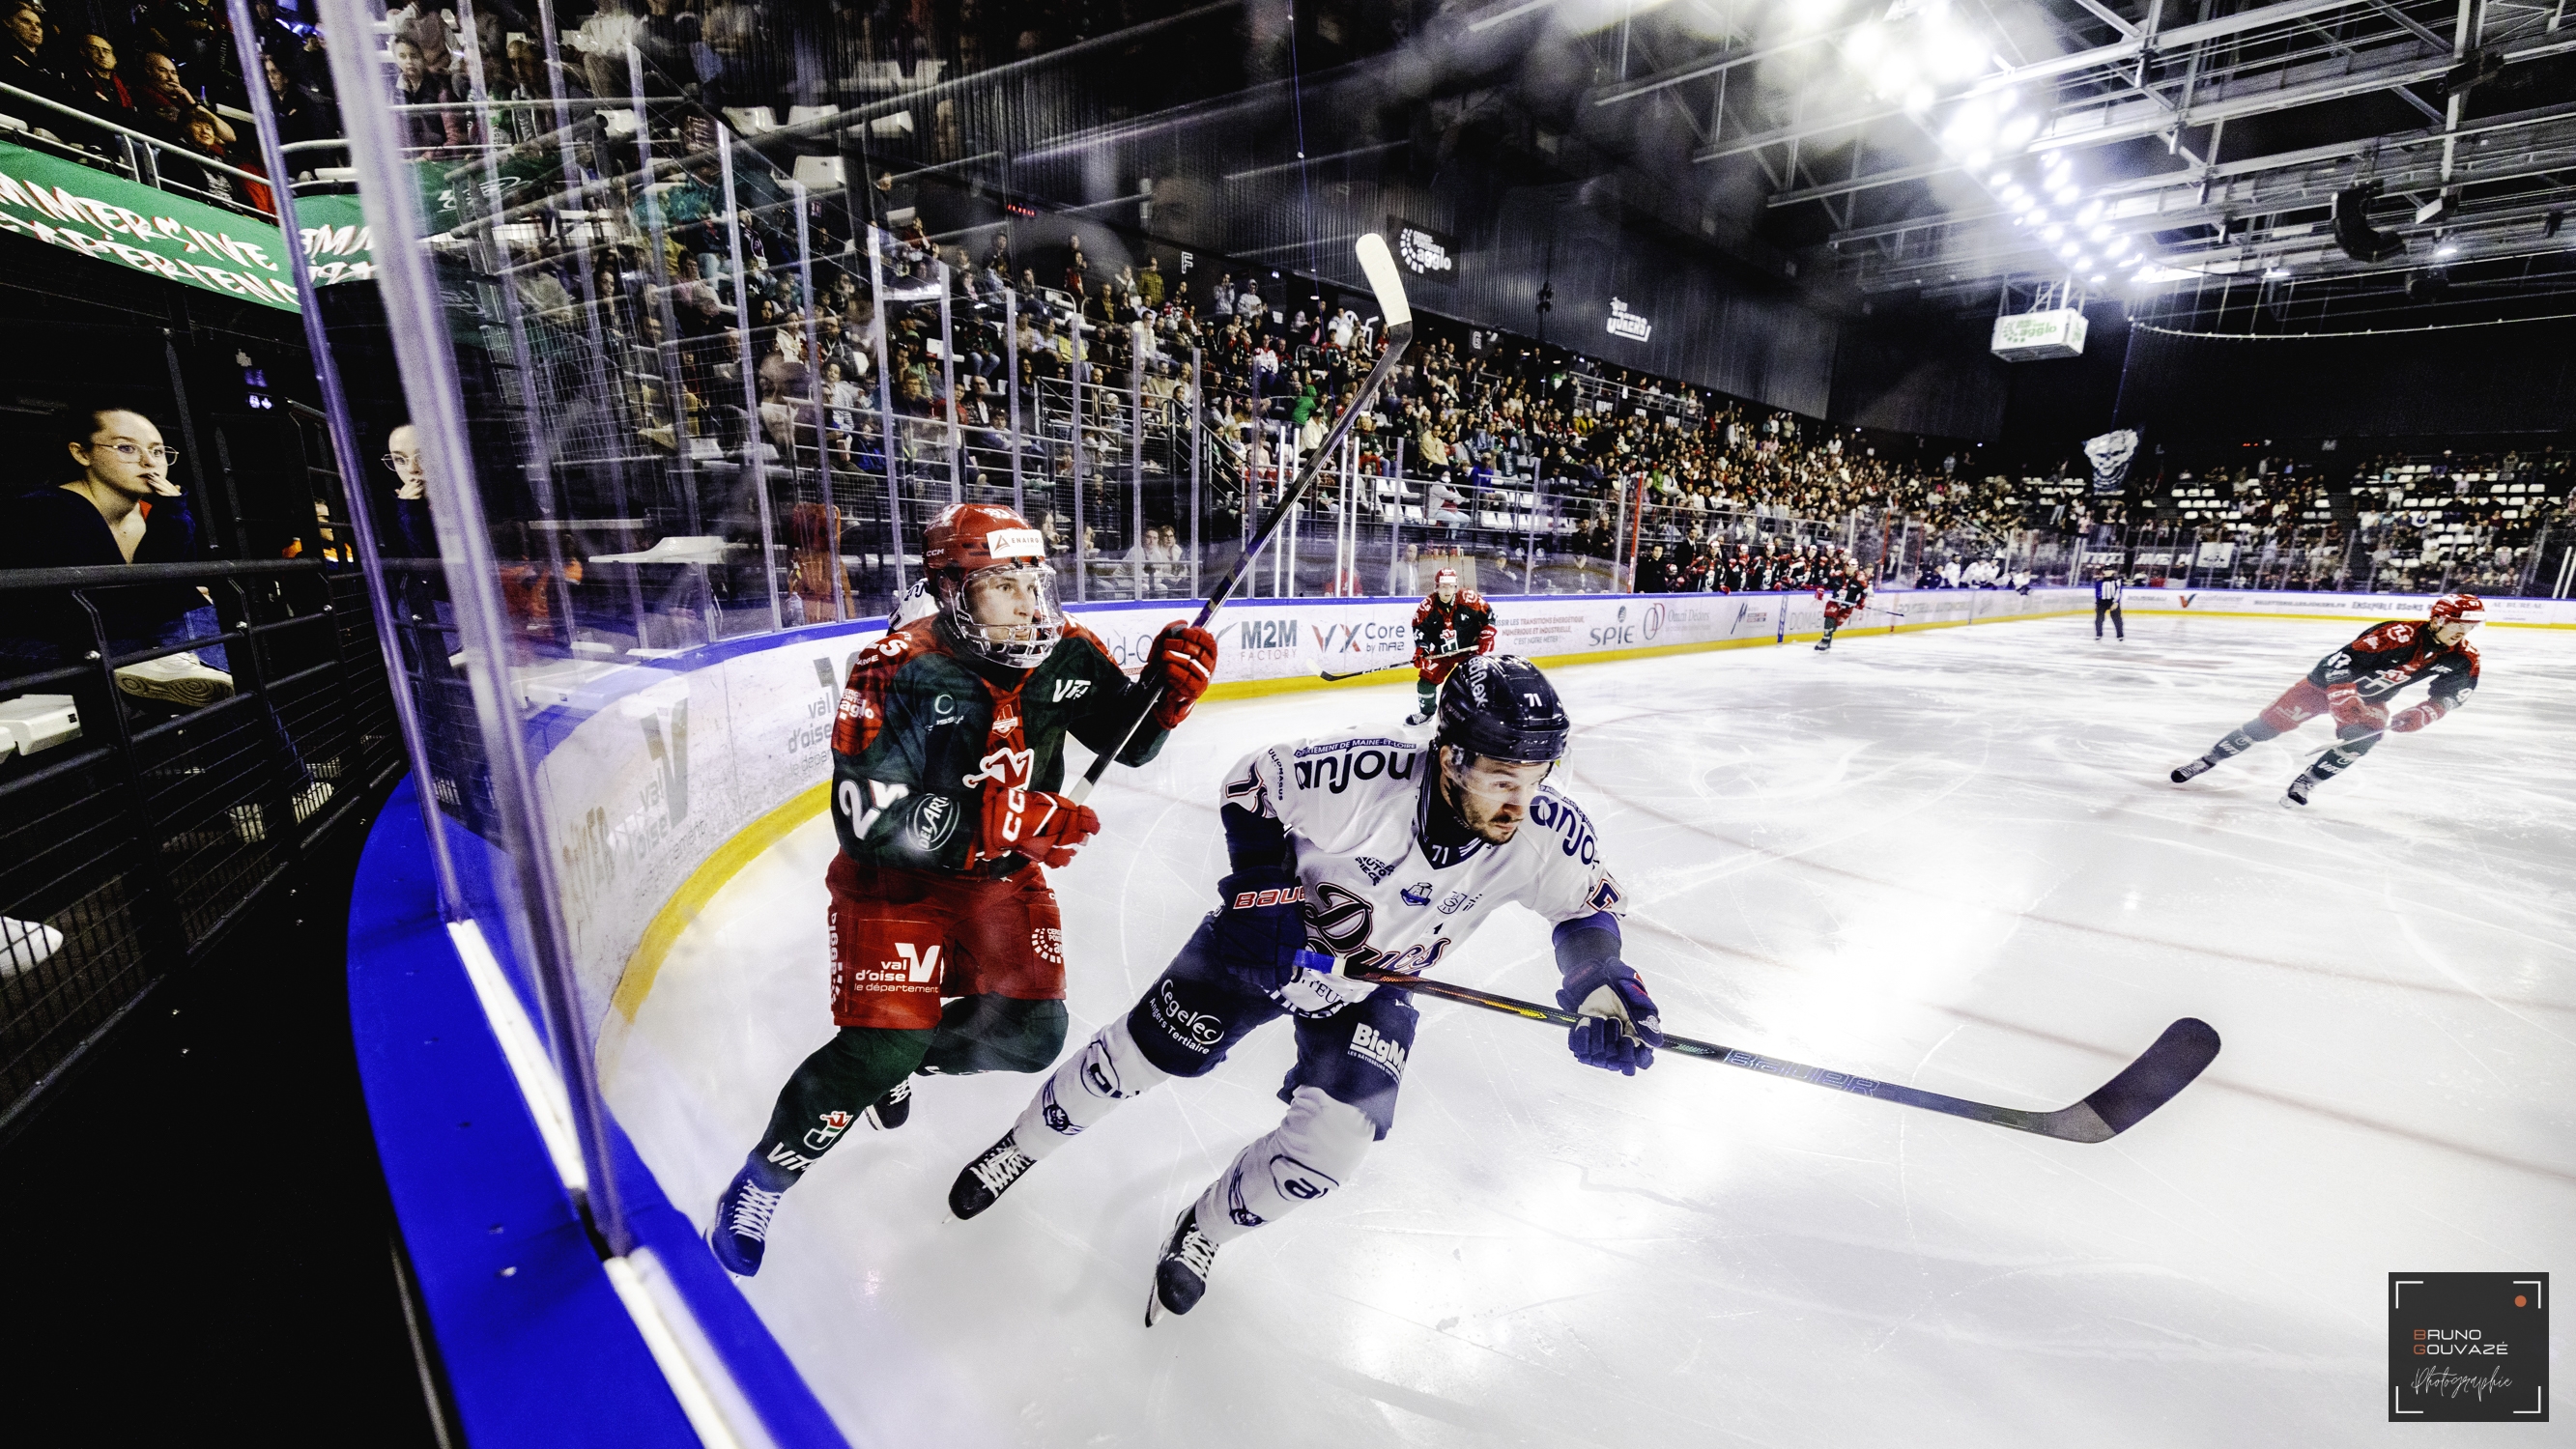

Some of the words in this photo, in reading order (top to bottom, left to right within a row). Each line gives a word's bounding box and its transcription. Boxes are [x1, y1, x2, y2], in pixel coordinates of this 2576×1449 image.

[926, 548, 945, 557] CCM
[1242, 619, 1298, 650] M2M
[1364, 622, 1405, 639] Core
[1589, 625, 1636, 647] SPIE
[1241, 649, 1297, 661] FACTORY
[808, 692, 832, 720] val
[1524, 693, 1543, 707] 71
[1294, 750, 1417, 794] anjou
[1530, 795, 1596, 866] anjo
[1432, 844, 1449, 865] 71
[881, 958, 907, 970] val
[855, 969, 906, 981] d'oise
[854, 982, 863, 991] le
[865, 982, 939, 994] département
[1160, 979, 1217, 1040] Cegelec
[1149, 998, 1168, 1029] Angers
[1167, 1025, 1210, 1055] Tertiaire
